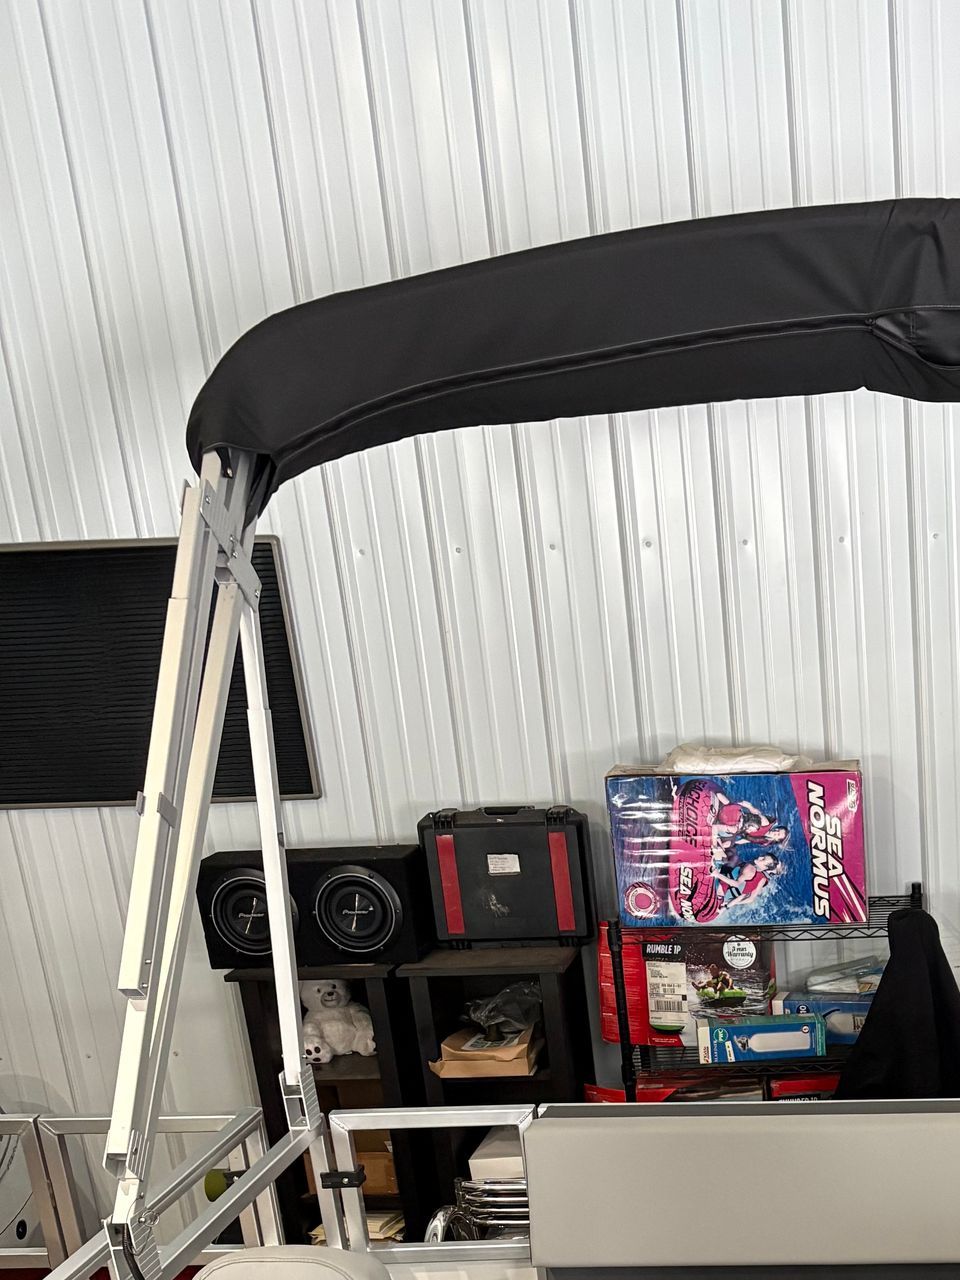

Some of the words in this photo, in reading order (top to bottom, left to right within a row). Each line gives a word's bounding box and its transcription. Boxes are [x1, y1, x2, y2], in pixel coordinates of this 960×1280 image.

[684, 781, 706, 848] EACHOICE
[825, 814, 844, 878] SEA
[680, 865, 693, 896] SEA
[808, 780, 830, 919] NORMUS
[646, 944, 672, 954] RUMBLE
[674, 945, 682, 954] 1P
